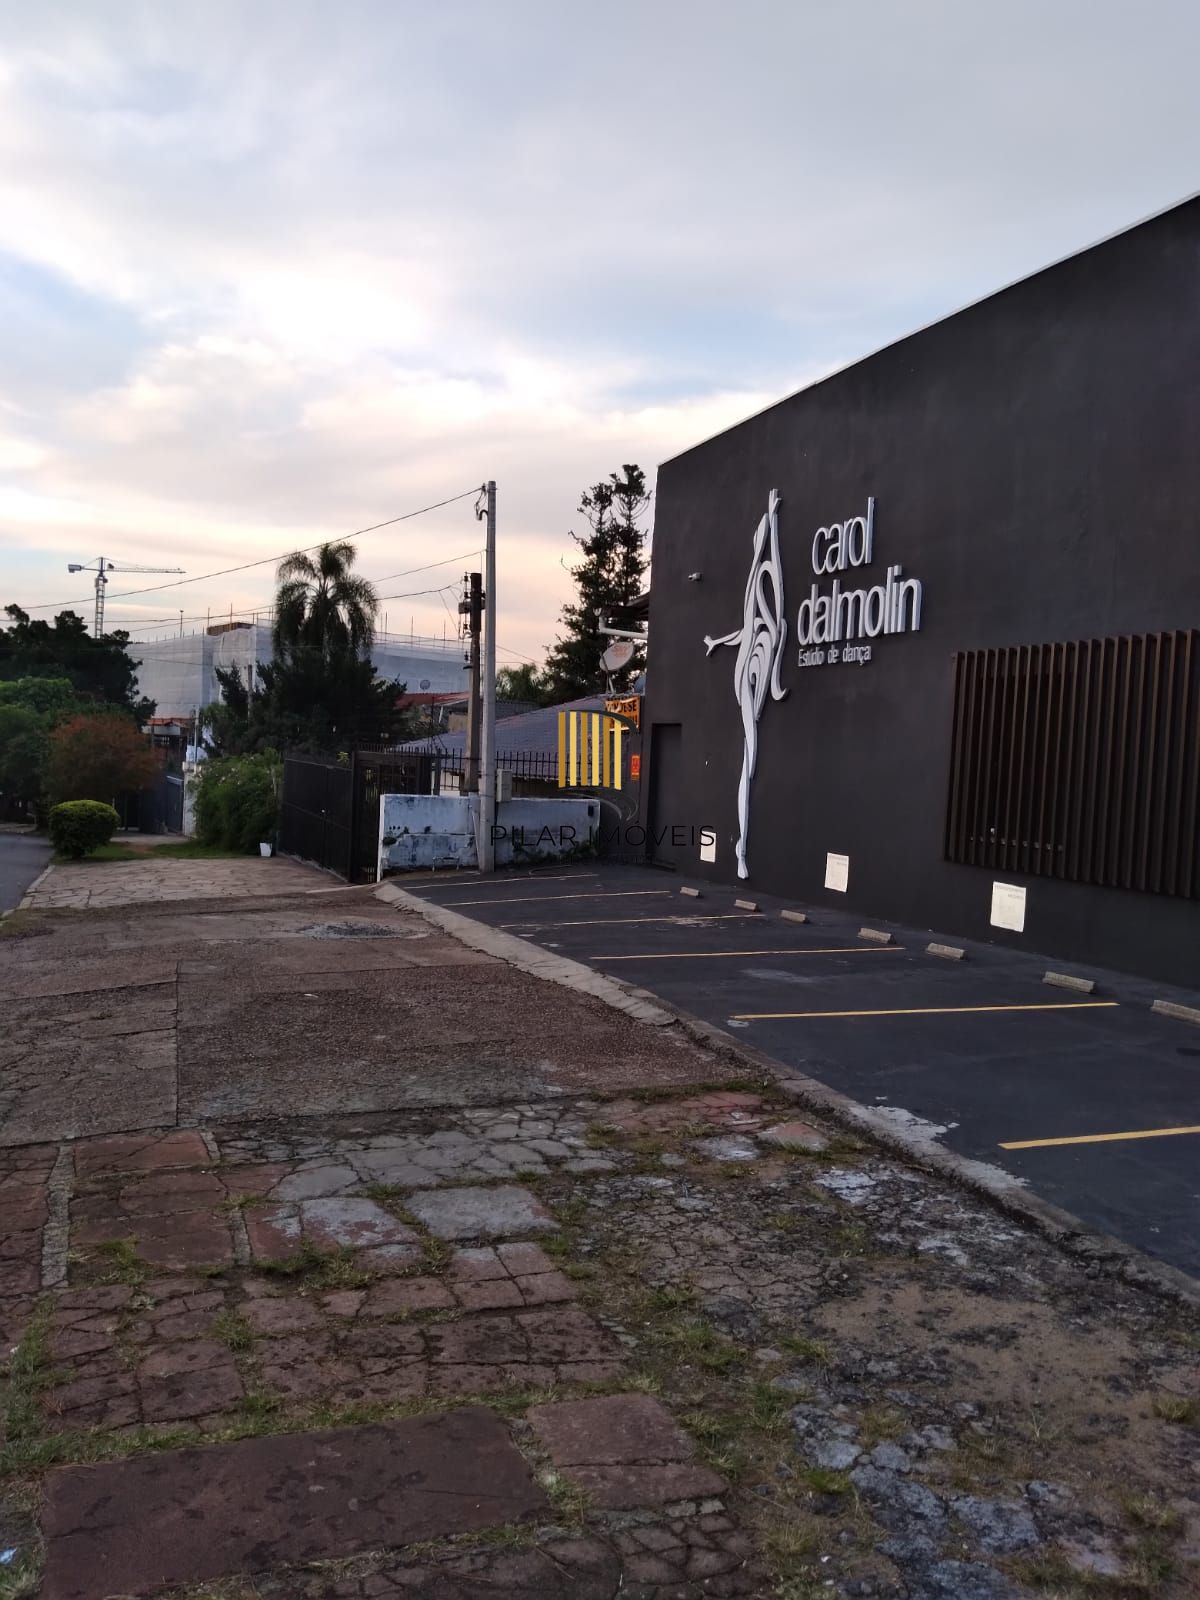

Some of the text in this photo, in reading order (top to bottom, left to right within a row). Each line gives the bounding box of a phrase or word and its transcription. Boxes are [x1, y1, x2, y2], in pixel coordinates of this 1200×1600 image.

[812, 496, 875, 575] carol
[797, 564, 922, 645] dalmolin
[827, 644, 840, 664] de
[842, 642, 872, 666] dança
